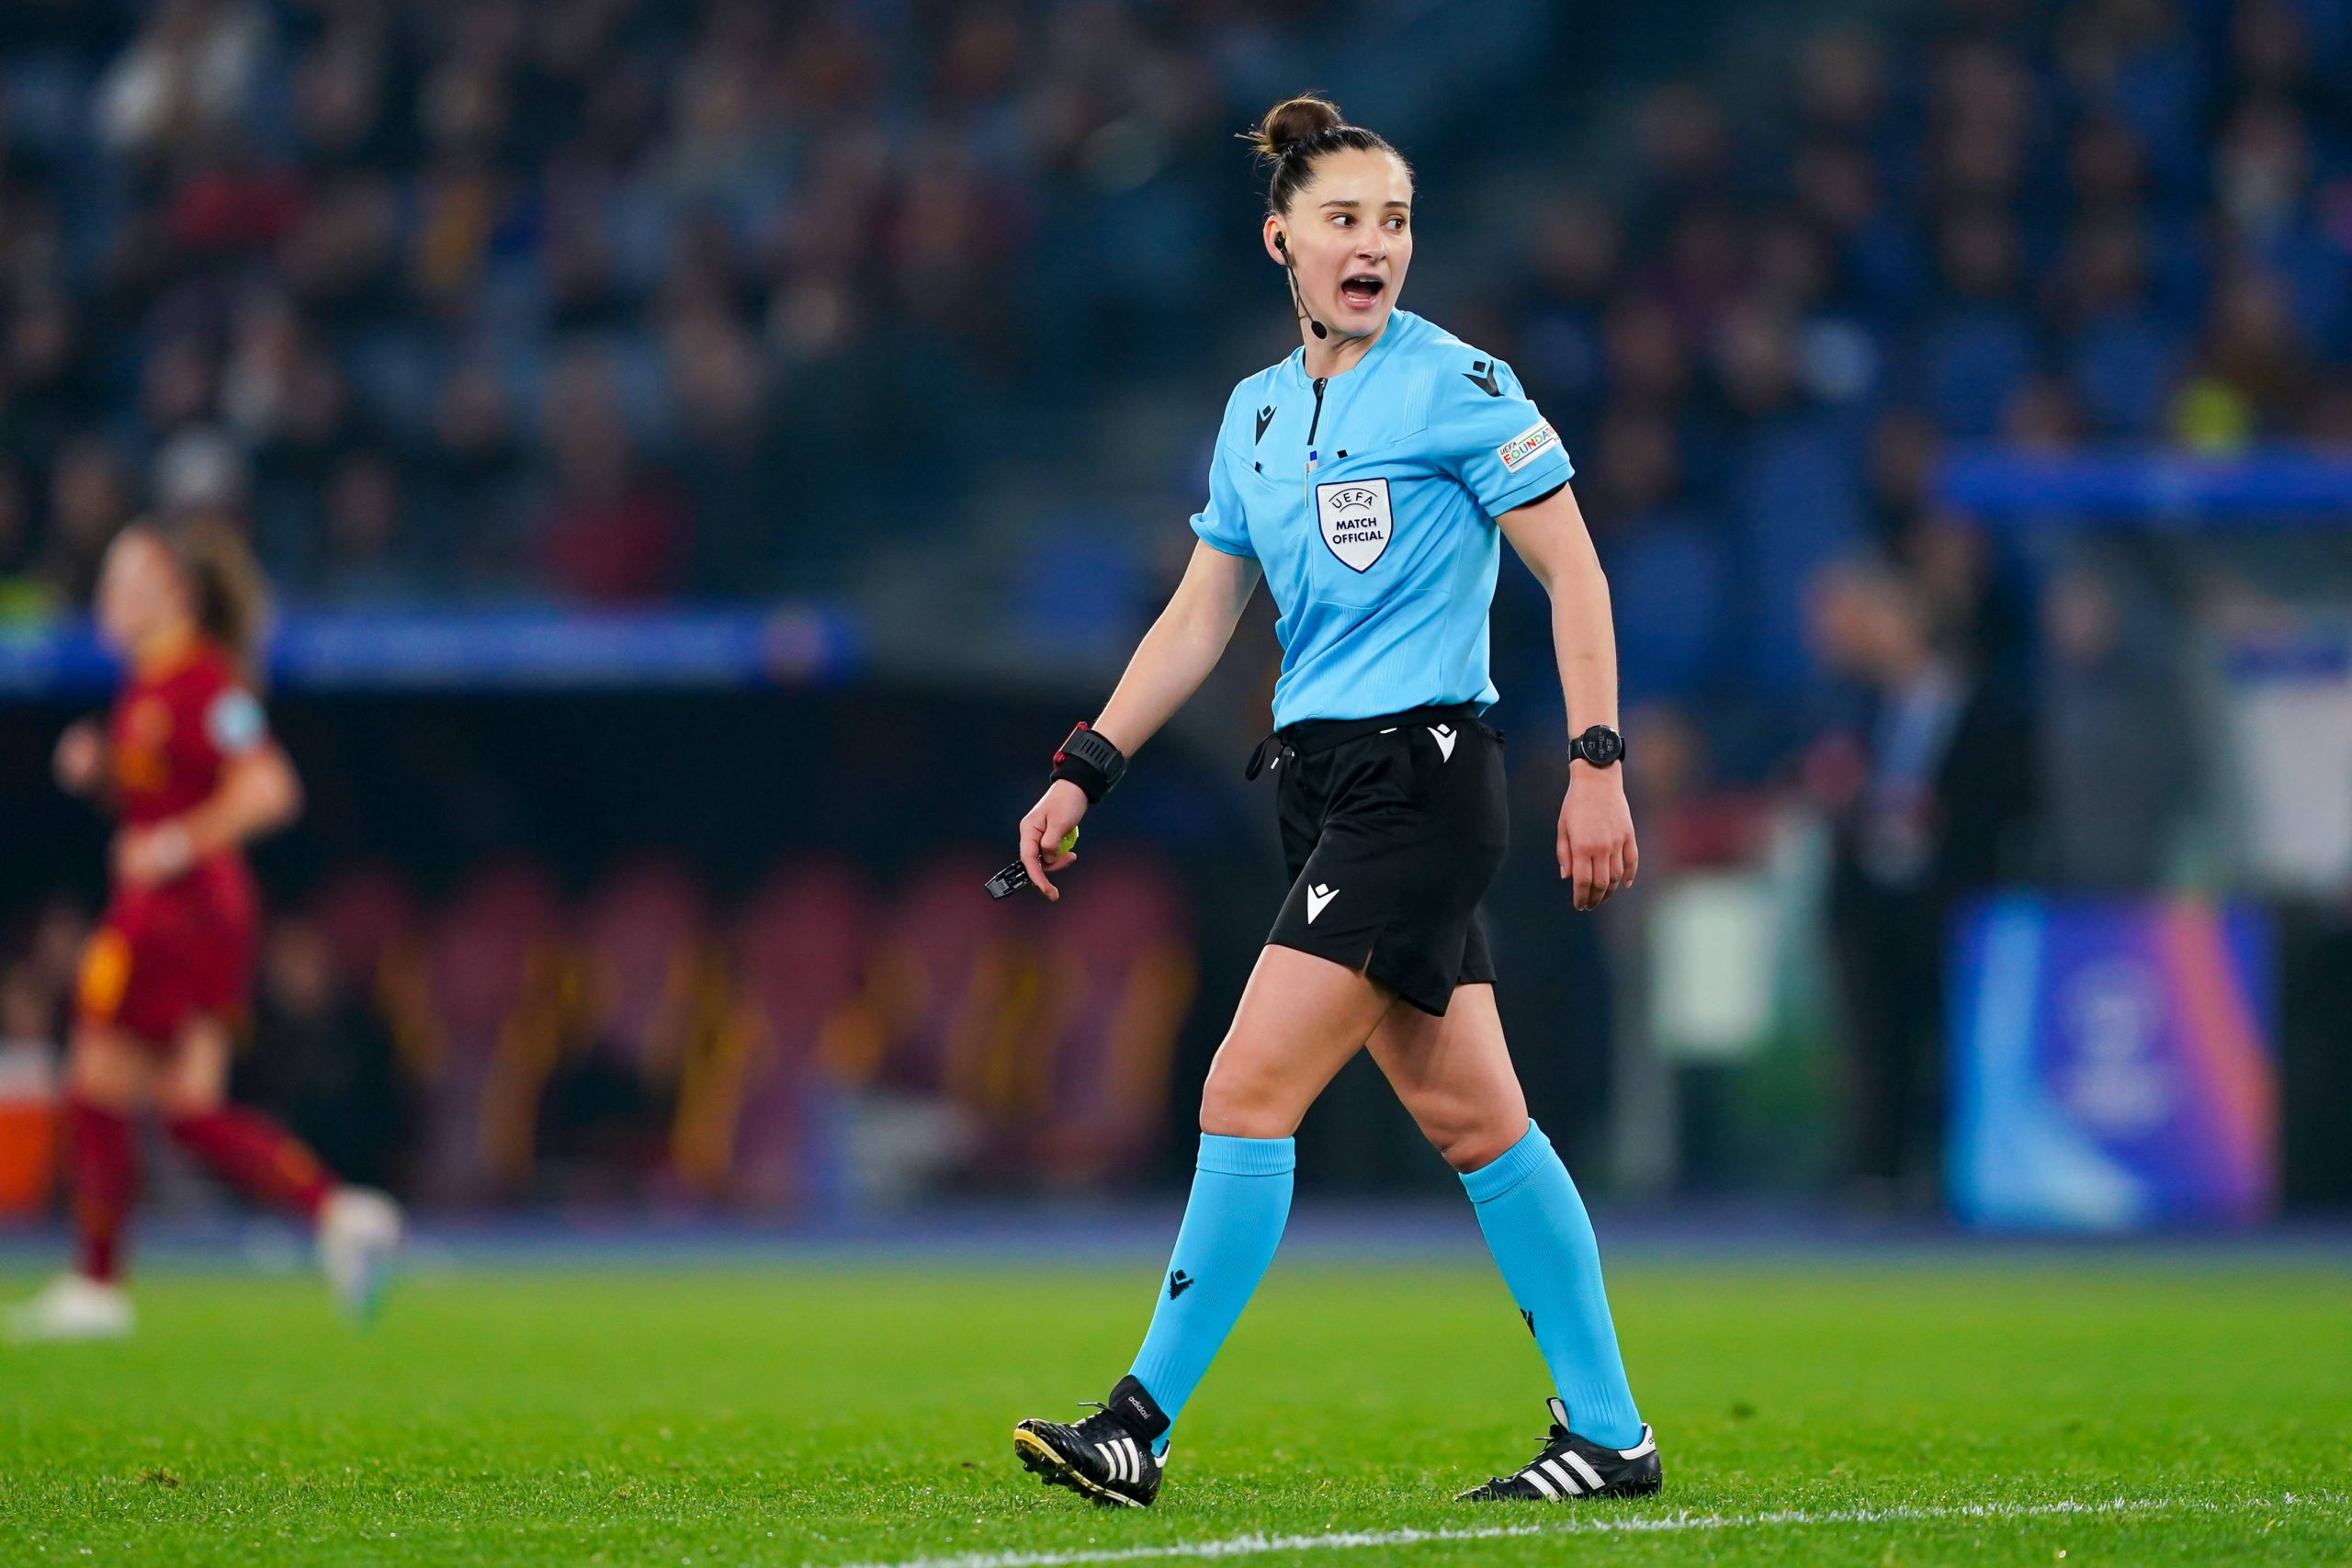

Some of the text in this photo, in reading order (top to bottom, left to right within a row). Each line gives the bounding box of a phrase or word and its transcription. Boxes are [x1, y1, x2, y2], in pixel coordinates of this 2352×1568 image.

[1331, 491, 1373, 509] UEFA
[1336, 517, 1377, 531] MATCH
[1332, 530, 1384, 545] OFFICIAL
